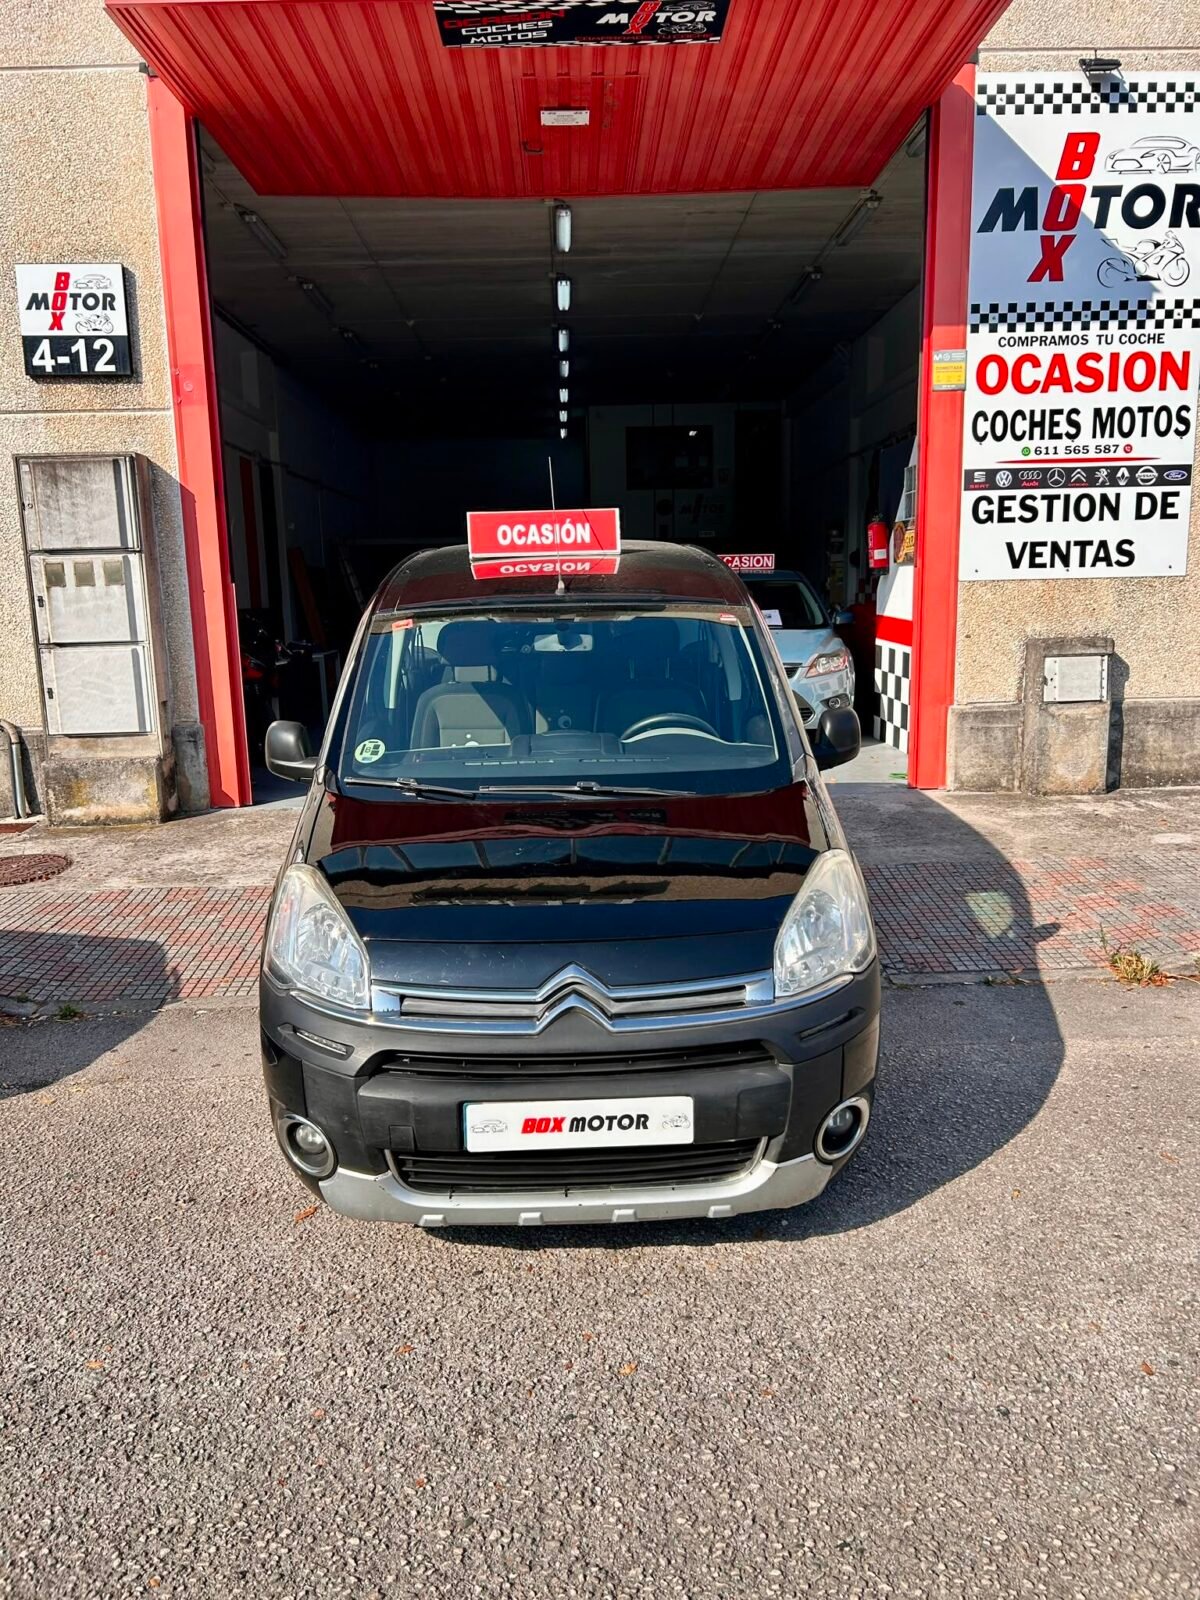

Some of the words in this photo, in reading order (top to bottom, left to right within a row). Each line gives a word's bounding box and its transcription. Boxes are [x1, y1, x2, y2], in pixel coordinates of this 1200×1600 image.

[443, 9, 565, 29] OCASION
[461, 20, 553, 35] COCHES
[595, 10, 717, 24] MOTOR
[622, 1, 662, 34] BOX
[470, 30, 548, 43] MOTOS
[976, 183, 1200, 233] MOTOR
[1026, 131, 1101, 283] BOX
[25, 292, 116, 311] MOTOR
[48, 272, 70, 331] BOX
[998, 334, 1089, 348] COMPRAMOS
[1096, 333, 1114, 345] TU
[1118, 333, 1165, 345] COCHE
[32, 338, 116, 372] 4-12
[976, 350, 1191, 396] OCASION
[972, 407, 1081, 442] COCHES
[1091, 404, 1191, 439] MOTOS
[1034, 446, 1059, 456] 611
[1064, 445, 1090, 455] 565
[1094, 444, 1120, 454] 587
[971, 492, 1121, 525] GESTION
[1135, 491, 1180, 521] DE
[497, 518, 591, 545] OCASIÓN
[723, 556, 772, 568] CASION
[1005, 538, 1135, 569] VENTAS
[521, 1117, 566, 1134] BOX
[568, 1113, 649, 1133] MOTOR
